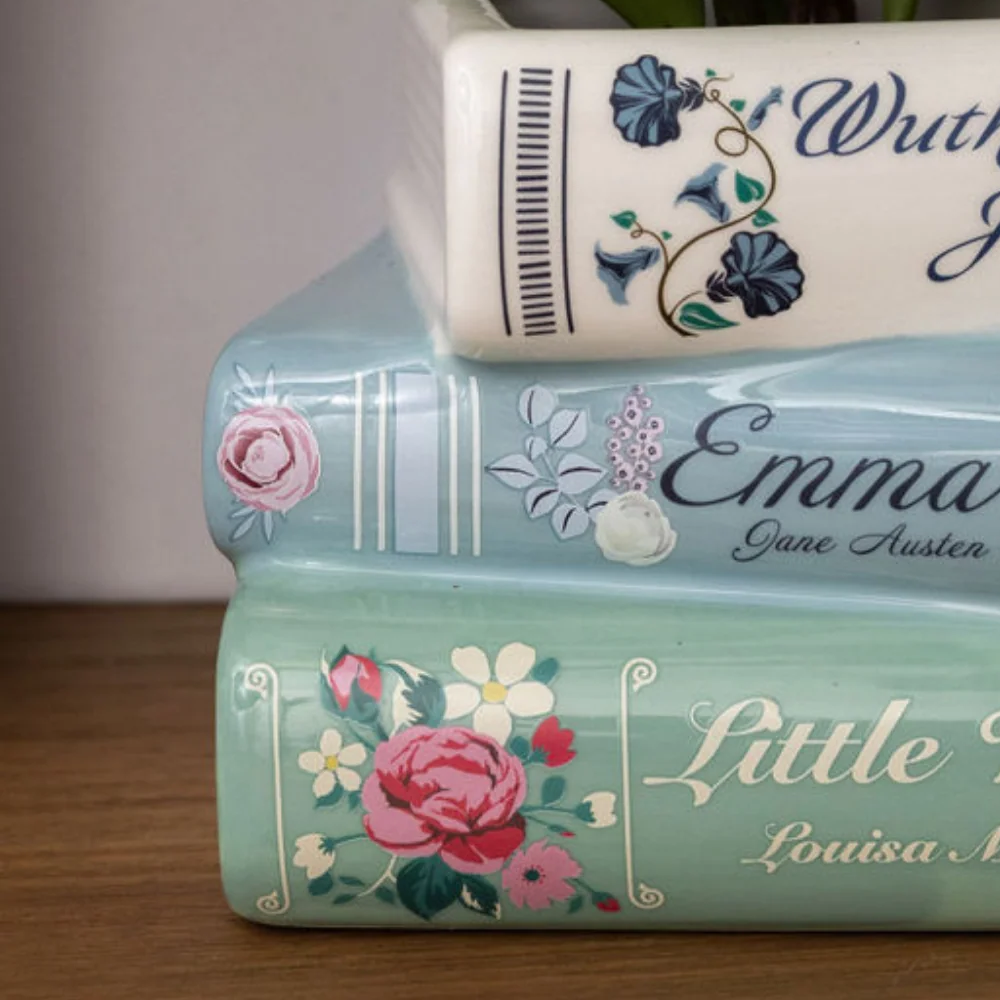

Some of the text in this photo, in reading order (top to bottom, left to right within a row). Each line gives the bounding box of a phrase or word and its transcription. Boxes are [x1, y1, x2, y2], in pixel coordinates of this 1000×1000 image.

[732, 518, 989, 563] Jane Austen
[643, 697, 954, 807] Little
[741, 821, 942, 872] Louisa
